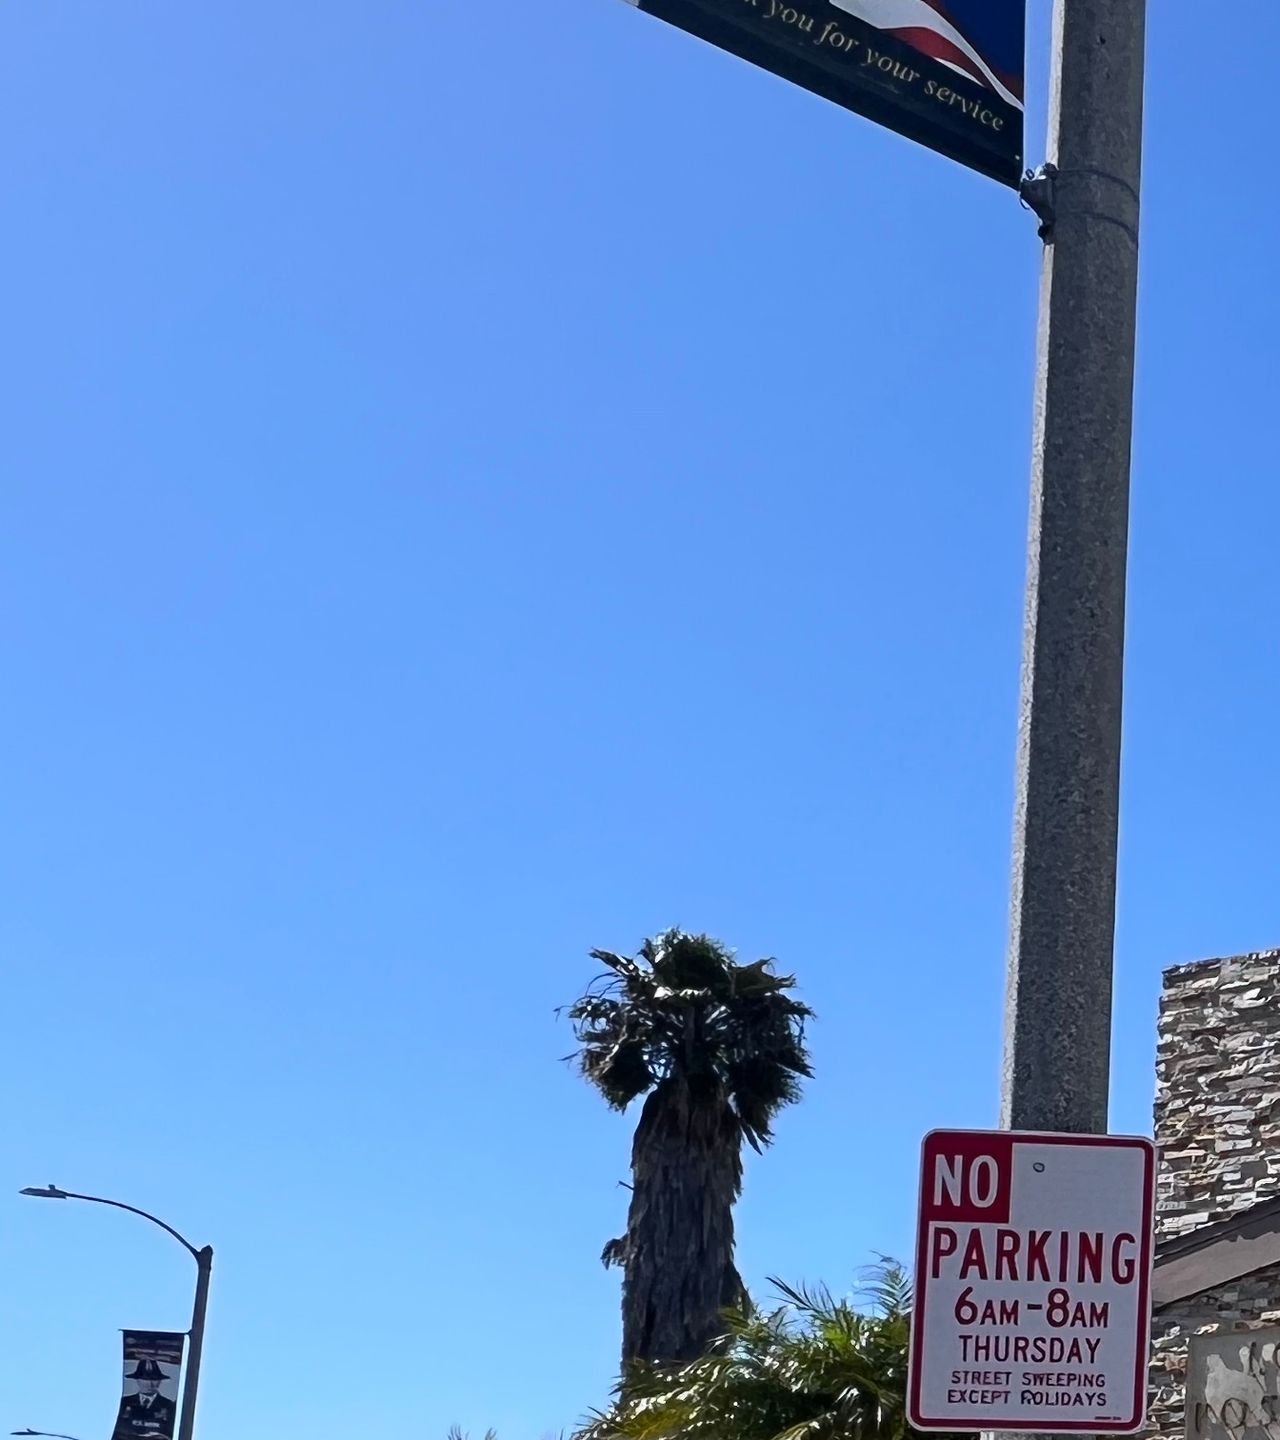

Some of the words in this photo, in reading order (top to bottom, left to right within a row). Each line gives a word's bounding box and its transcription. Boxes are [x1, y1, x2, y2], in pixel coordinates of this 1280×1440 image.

[762, 0, 814, 32] you
[813, 21, 859, 52] for
[861, 48, 920, 82] your
[924, 79, 1004, 131] service
[933, 1153, 999, 1209] NO
[931, 1227, 1136, 1285] PARKING
[958, 1334, 1101, 1364] THURSDAY
[947, 1389, 1012, 1404] EXCEPT
[951, 1370, 1013, 1386] STREET
[1021, 1372, 1106, 1388] SWEEPING
